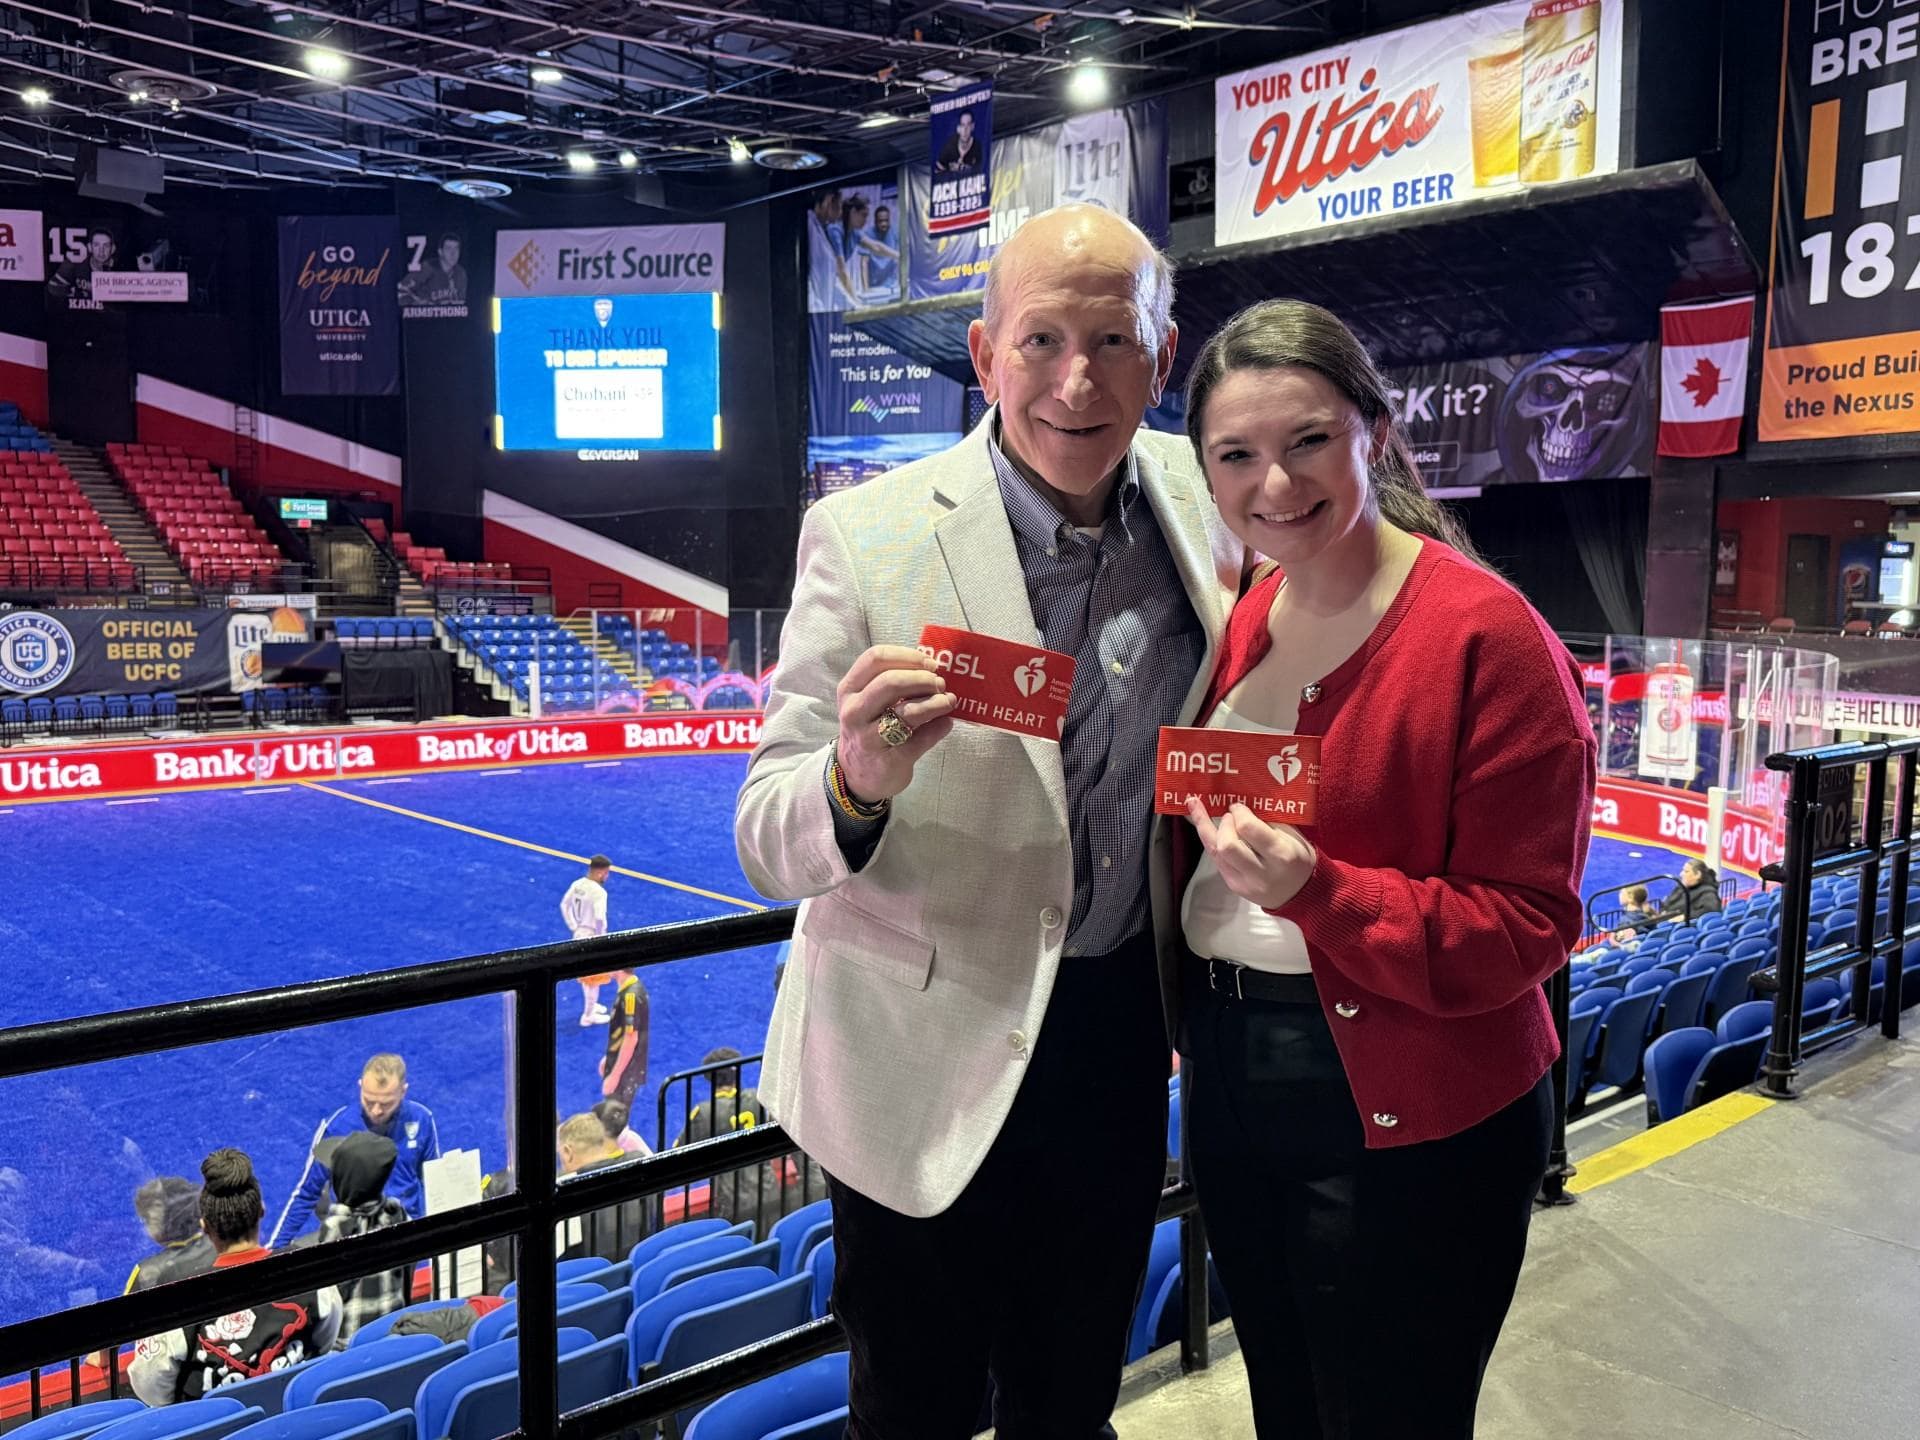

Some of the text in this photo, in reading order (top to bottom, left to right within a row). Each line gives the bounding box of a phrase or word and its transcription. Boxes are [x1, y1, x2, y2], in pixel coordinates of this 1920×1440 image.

[1231, 57, 1351, 110] YOUR CITY
[1248, 68, 1445, 217] Utica
[1317, 173, 1455, 221] YOUR BEER
[49, 227, 88, 263] 15
[323, 246, 355, 262] GO
[407, 235, 427, 272] 7
[298, 248, 389, 302] beyond
[557, 246, 713, 280] First Source
[309, 309, 371, 327] UTICA
[402, 306, 468, 318] ARMSTRONG
[316, 333, 367, 341] UNIVERSITY
[549, 327, 662, 349] THANK YOU
[829, 332, 852, 344] New
[319, 352, 363, 361] utica.edu
[1787, 350, 1920, 384] Proud Bui
[840, 364, 931, 383] This is for You
[563, 384, 627, 401] Chobani
[880, 393, 921, 406] WYNN
[1442, 383, 1488, 417] it?
[1784, 392, 1914, 420] the Nexus
[36, 619, 62, 640] CITY
[102, 620, 198, 638] OFFICIAL
[234, 625, 268, 647] Lite
[107, 642, 197, 660] BEER OF
[124, 664, 182, 681] UCFC
[993, 706, 1047, 728] HEART
[1843, 697, 1856, 723] THE
[1858, 699, 1899, 726] HELL
[417, 726, 588, 763] Bank of Utica
[623, 721, 693, 748] Bank
[693, 723, 716, 748] of
[154, 740, 375, 782] Bank of Utica
[1166, 750, 1239, 774] MASL
[0, 758, 103, 792] Utica
[1208, 792, 1247, 808] WITH
[1253, 797, 1307, 815] HEART
[1658, 801, 1709, 845] Ban
[1721, 824, 1741, 859] of
[1822, 801, 1848, 848] 02
